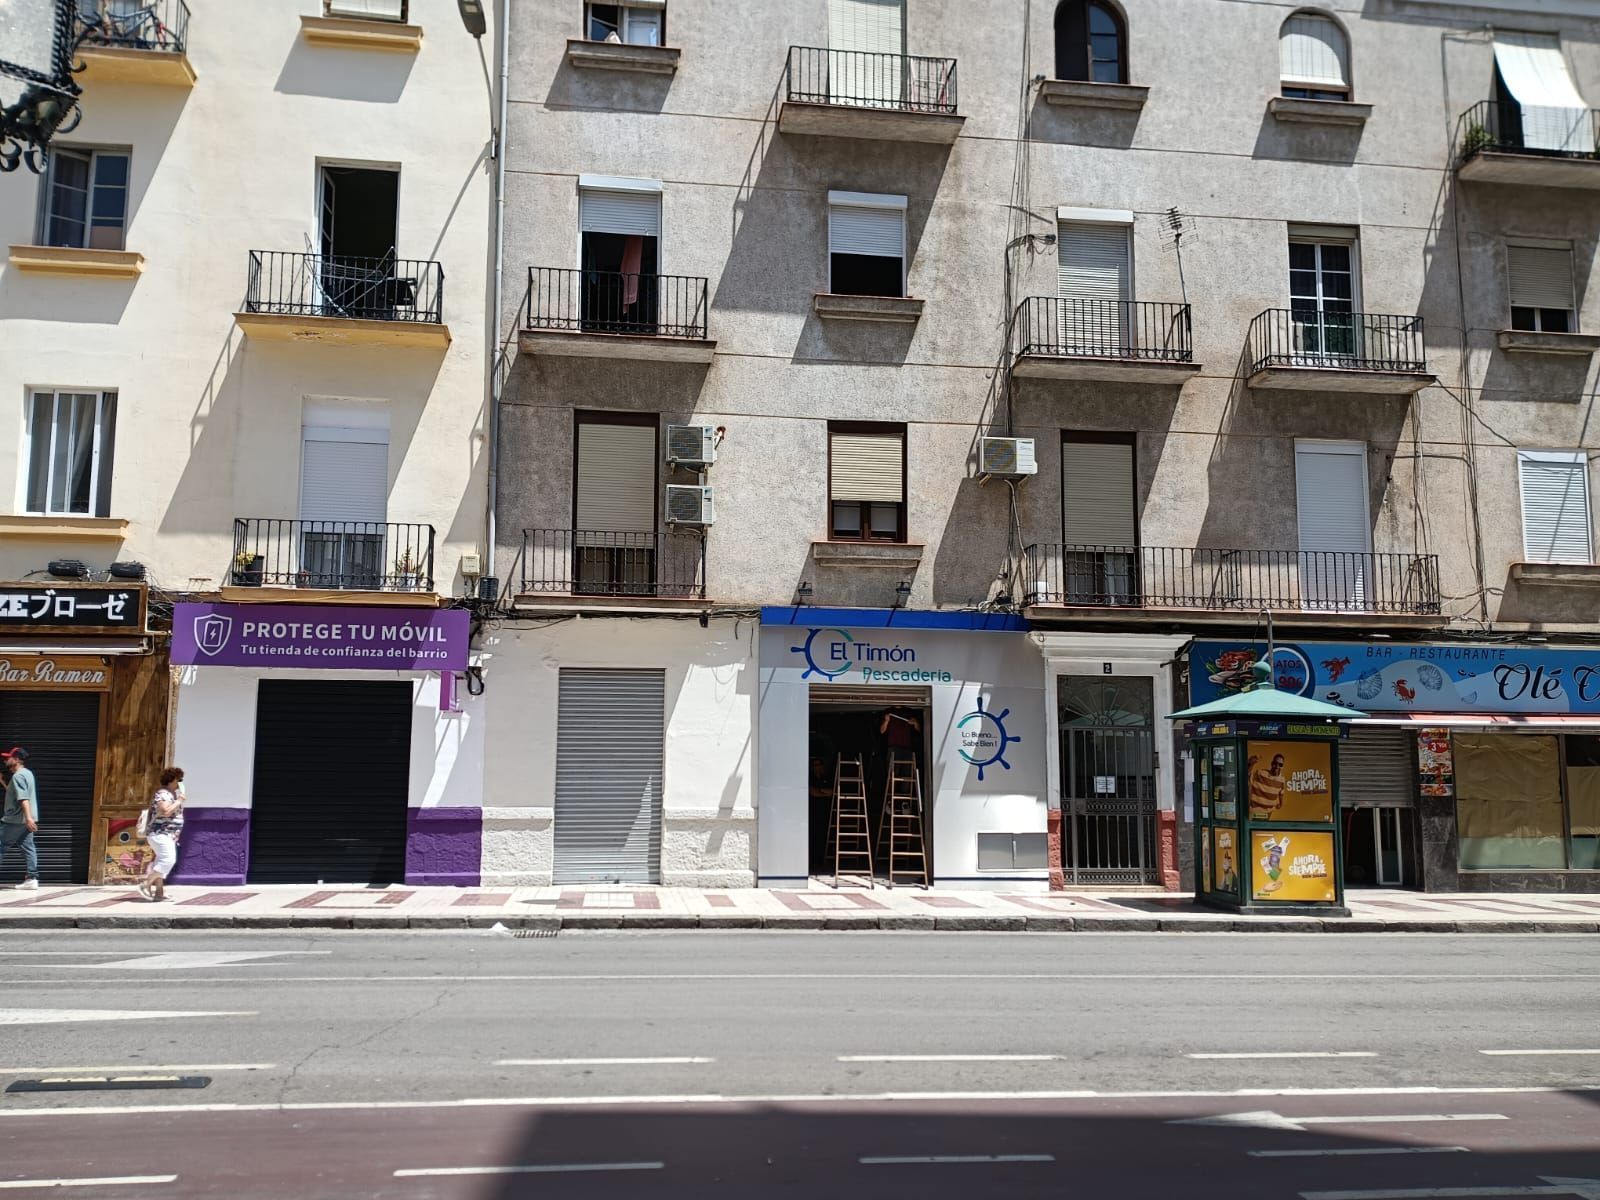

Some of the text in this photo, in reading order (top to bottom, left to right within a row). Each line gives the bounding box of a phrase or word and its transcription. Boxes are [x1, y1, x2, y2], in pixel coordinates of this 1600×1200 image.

[242, 621, 447, 642] PROTEGE TU MÓVIL
[241, 644, 448, 659] Tu tienda de confianza del barrio
[831, 642, 915, 663] El Timón
[1366, 646, 1393, 658] BAR
[1409, 647, 1505, 661] RESTAURANTE
[31, 660, 104, 682] Ramen
[1104, 664, 1111, 673] 2
[1494, 663, 1563, 701] Olé
[1286, 778, 1327, 793] SIEMPRE
[1288, 863, 1326, 877] SIEMPRE
